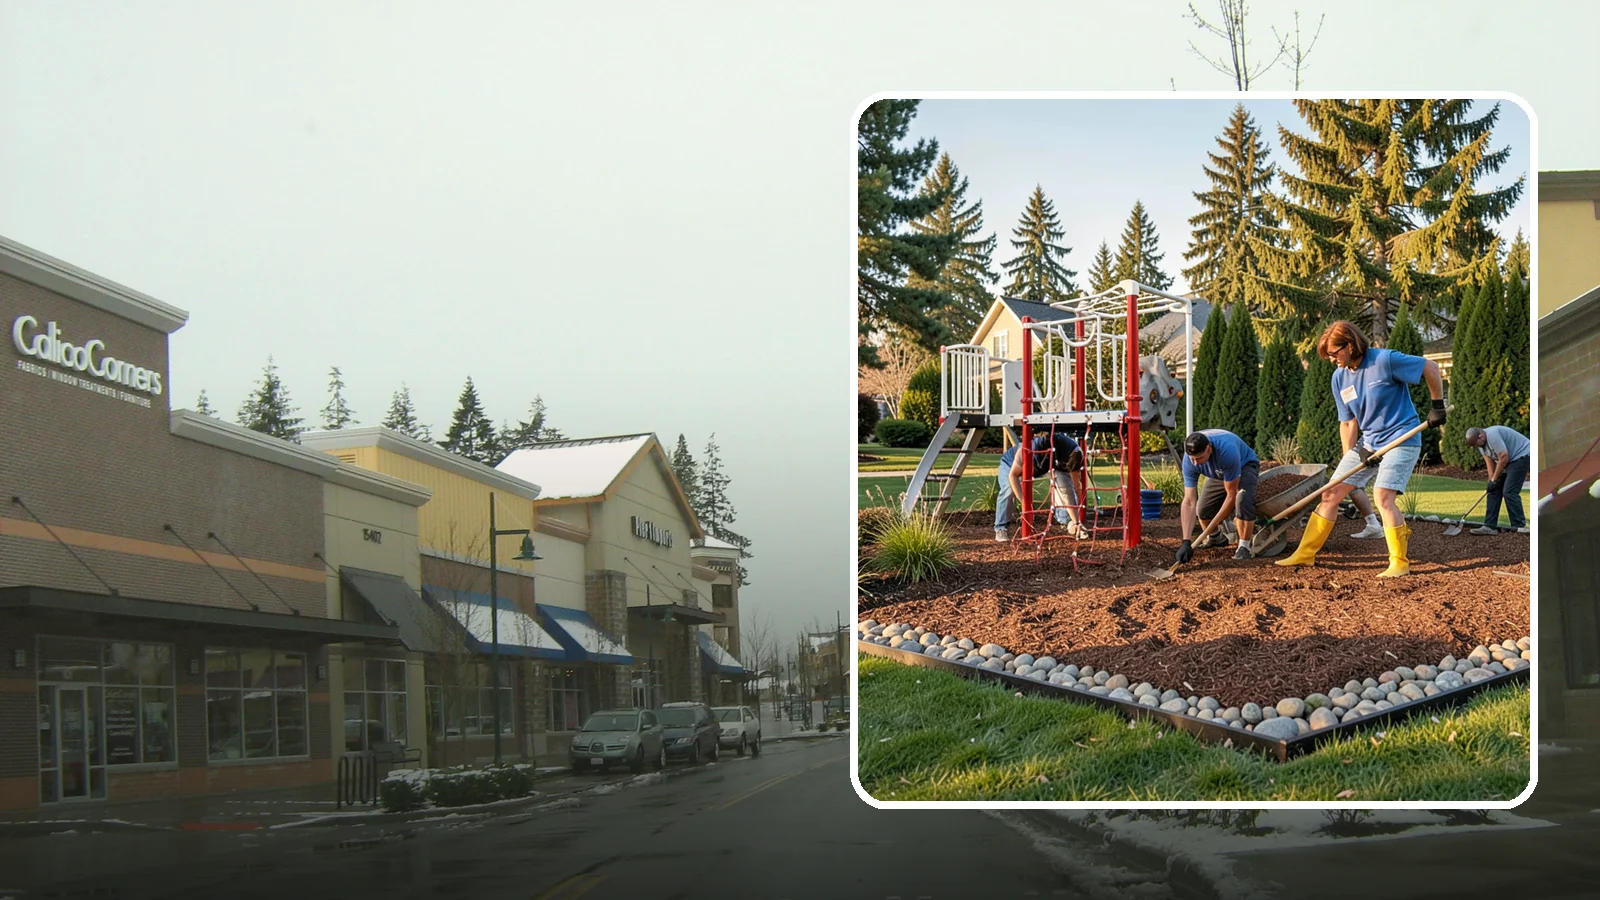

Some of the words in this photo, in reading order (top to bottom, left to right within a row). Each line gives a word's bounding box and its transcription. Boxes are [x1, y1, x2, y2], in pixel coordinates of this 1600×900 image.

[17, 360, 47, 378] FABRICS
[51, 370, 78, 386] WINDOW
[78, 378, 117, 398] TREATMENTS
[120, 391, 151, 408] FURNITURE
